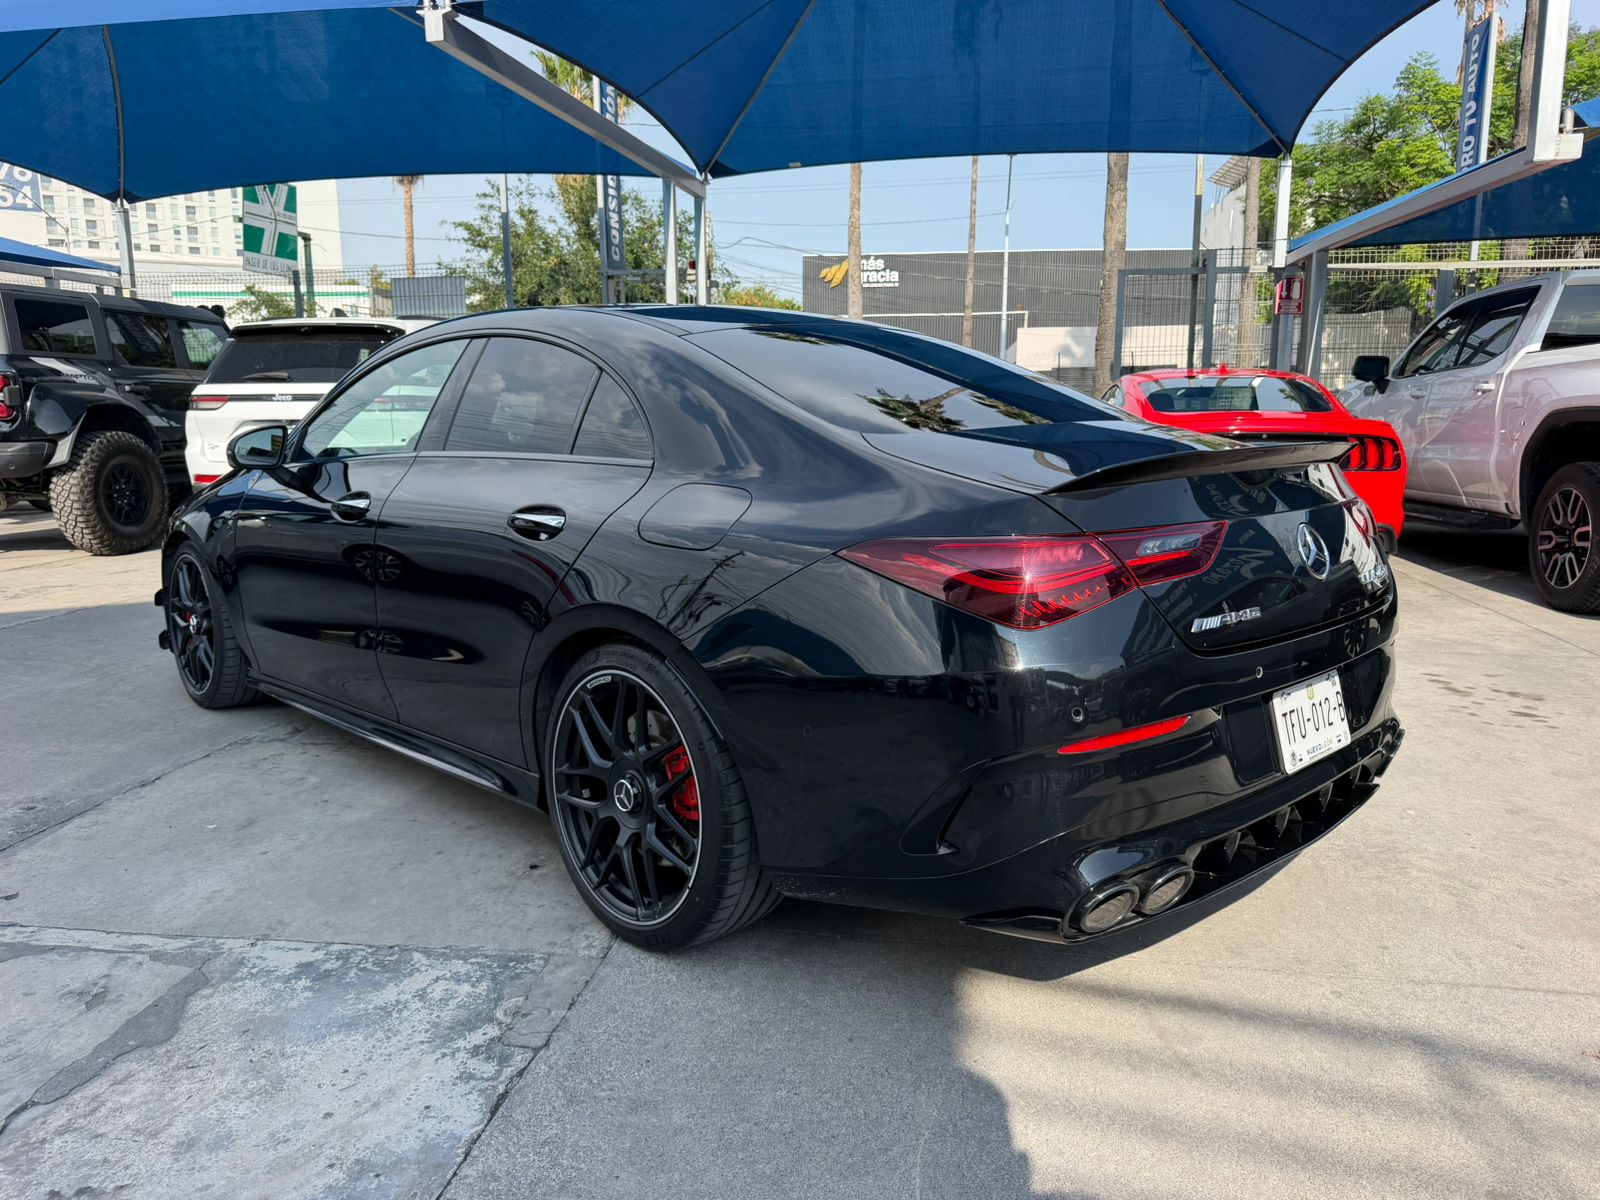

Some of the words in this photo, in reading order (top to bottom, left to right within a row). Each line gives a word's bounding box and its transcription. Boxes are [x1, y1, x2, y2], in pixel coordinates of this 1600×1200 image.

[1467, 33, 1480, 93] AUTO
[1463, 100, 1477, 132] TU
[860, 269, 899, 284] racia
[272, 393, 293, 402] Jeep
